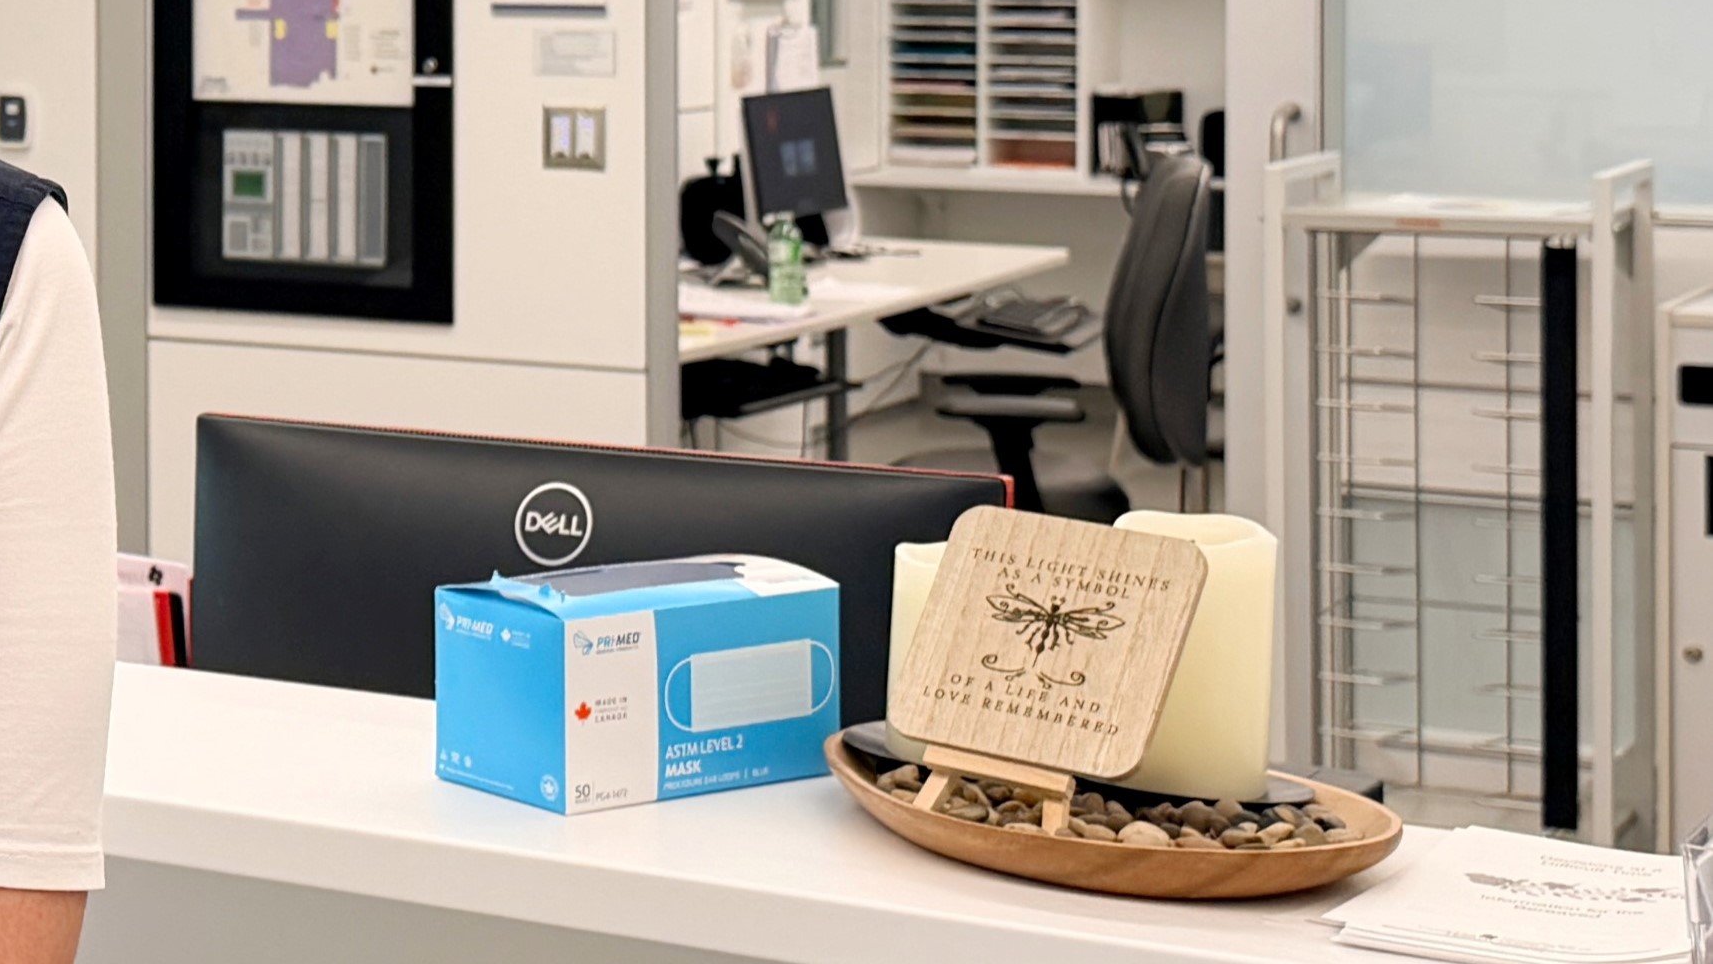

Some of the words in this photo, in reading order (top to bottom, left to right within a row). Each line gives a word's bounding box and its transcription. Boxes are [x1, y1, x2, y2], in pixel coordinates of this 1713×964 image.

[524, 511, 583, 536] DELL
[972, 547, 1017, 565] THIS
[1026, 556, 1087, 577] LIGHT
[1097, 568, 1171, 591] SHINES
[997, 567, 1021, 579] AS
[1030, 573, 1042, 584] A
[1052, 576, 1130, 599] SYMBOL
[950, 674, 976, 687] OF
[984, 681, 994, 692] A
[1005, 684, 1050, 702] LIFE
[1059, 696, 1102, 713] AND
[923, 685, 972, 704] LOVE
[981, 696, 1120, 736] REMEMBERED
[665, 742, 698, 759] ASTM
[700, 736, 734, 754] LEVEL
[736, 734, 744, 749] 2
[665, 759, 701, 778] MASK
[575, 784, 591, 799] 50
